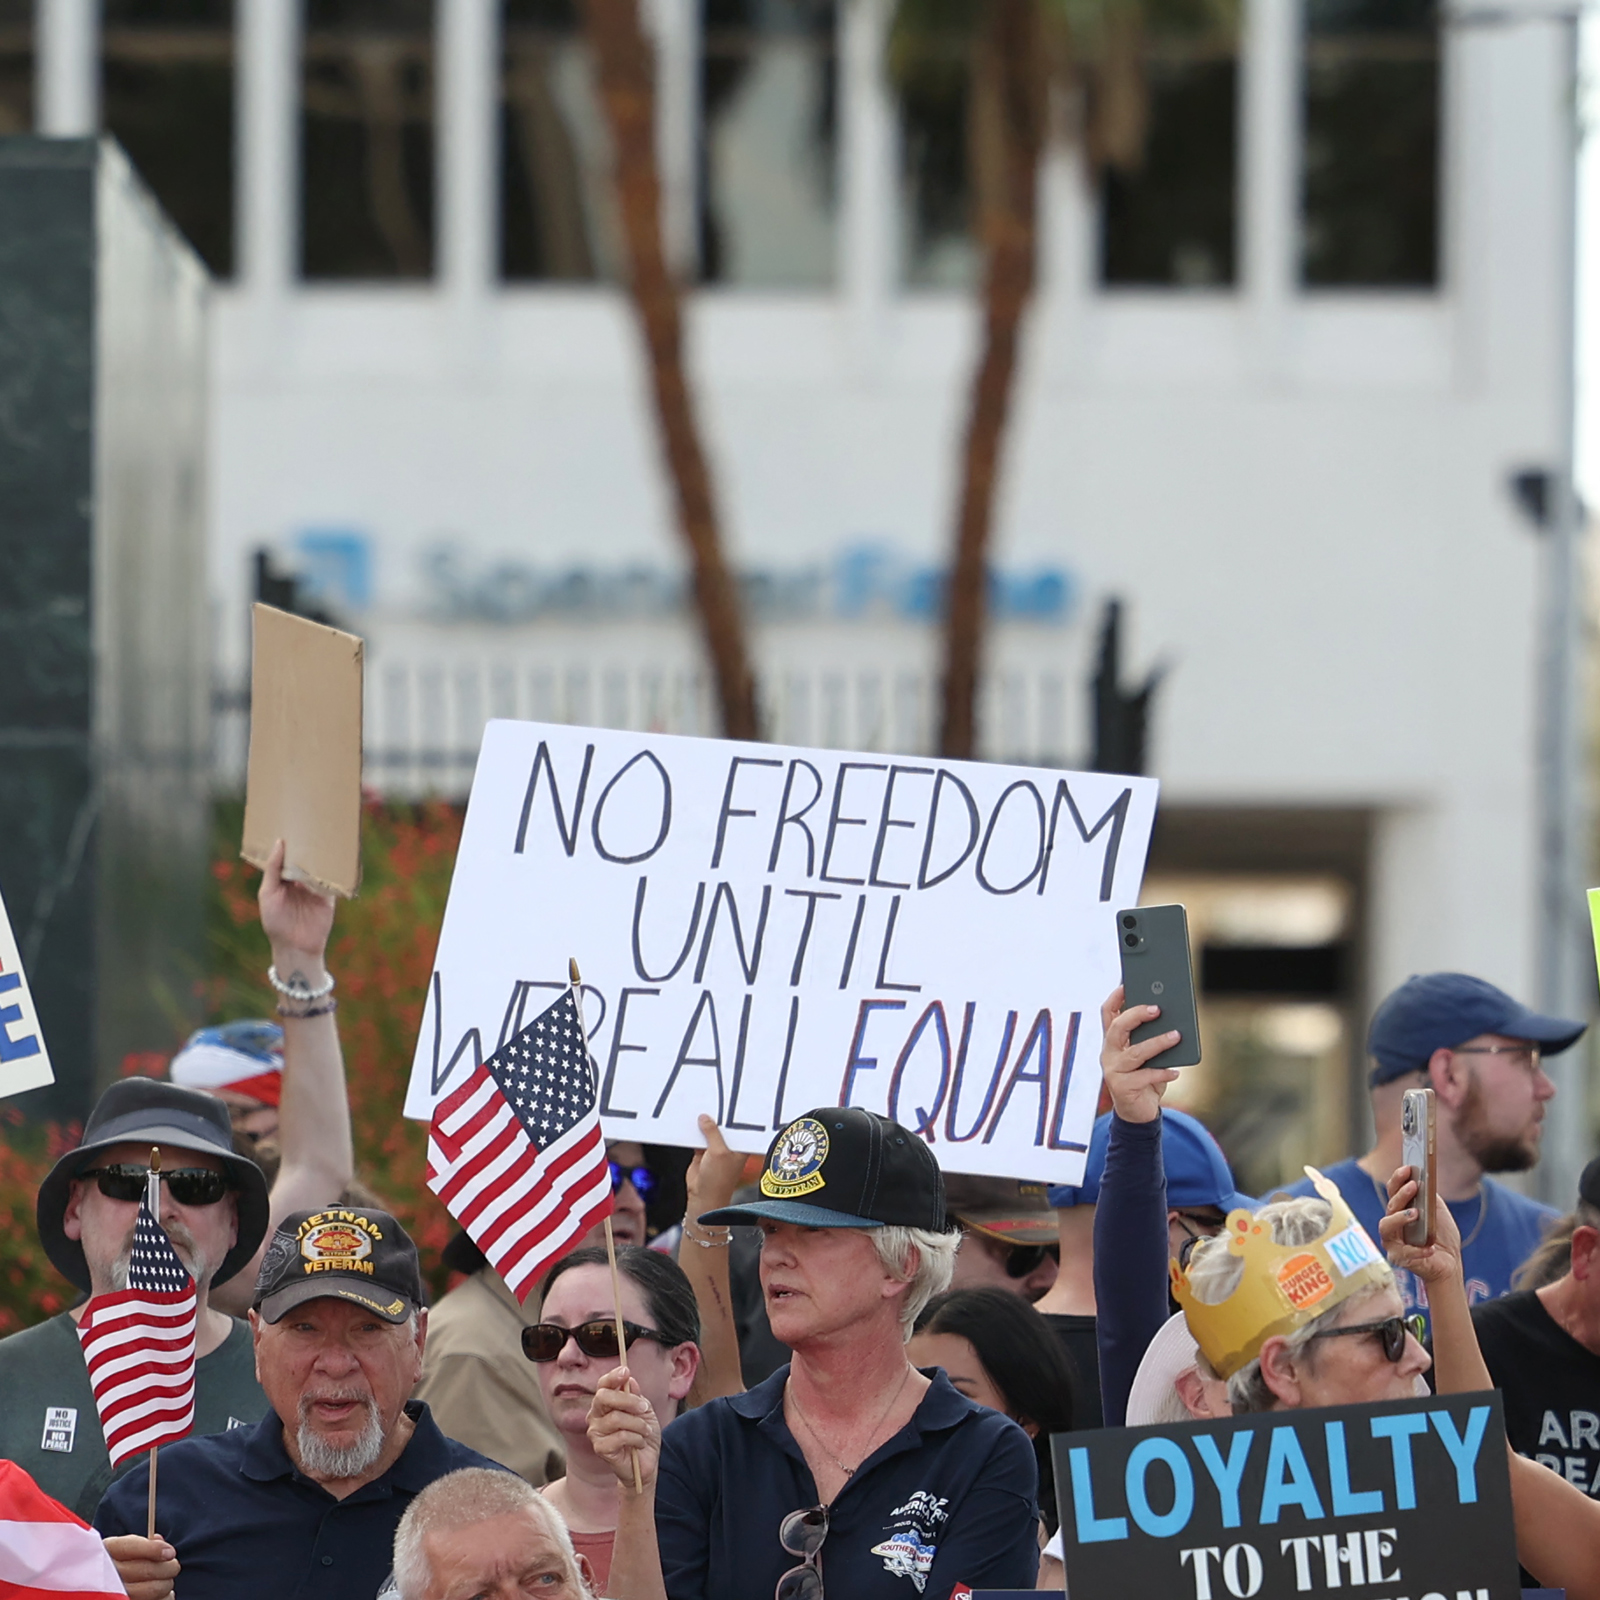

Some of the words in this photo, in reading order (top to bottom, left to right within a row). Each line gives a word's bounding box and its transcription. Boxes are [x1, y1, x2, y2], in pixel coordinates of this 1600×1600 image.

[515, 741, 673, 865] NO
[710, 757, 1134, 902] FREEDOM
[631, 876, 923, 993] UNTIL
[839, 1001, 1089, 1154] EQUAL
[295, 1210, 383, 1241] VIETNAM
[304, 1260, 374, 1275] VETERAN
[1330, 1230, 1369, 1272] NO
[1281, 1262, 1322, 1292] BURGER
[1287, 1271, 1330, 1305] KING
[55, 1410, 68, 1419] NO
[52, 1432, 66, 1441] NO
[1068, 1406, 1491, 1543] LOYALTY
[1280, 1528, 1401, 1591] THE
